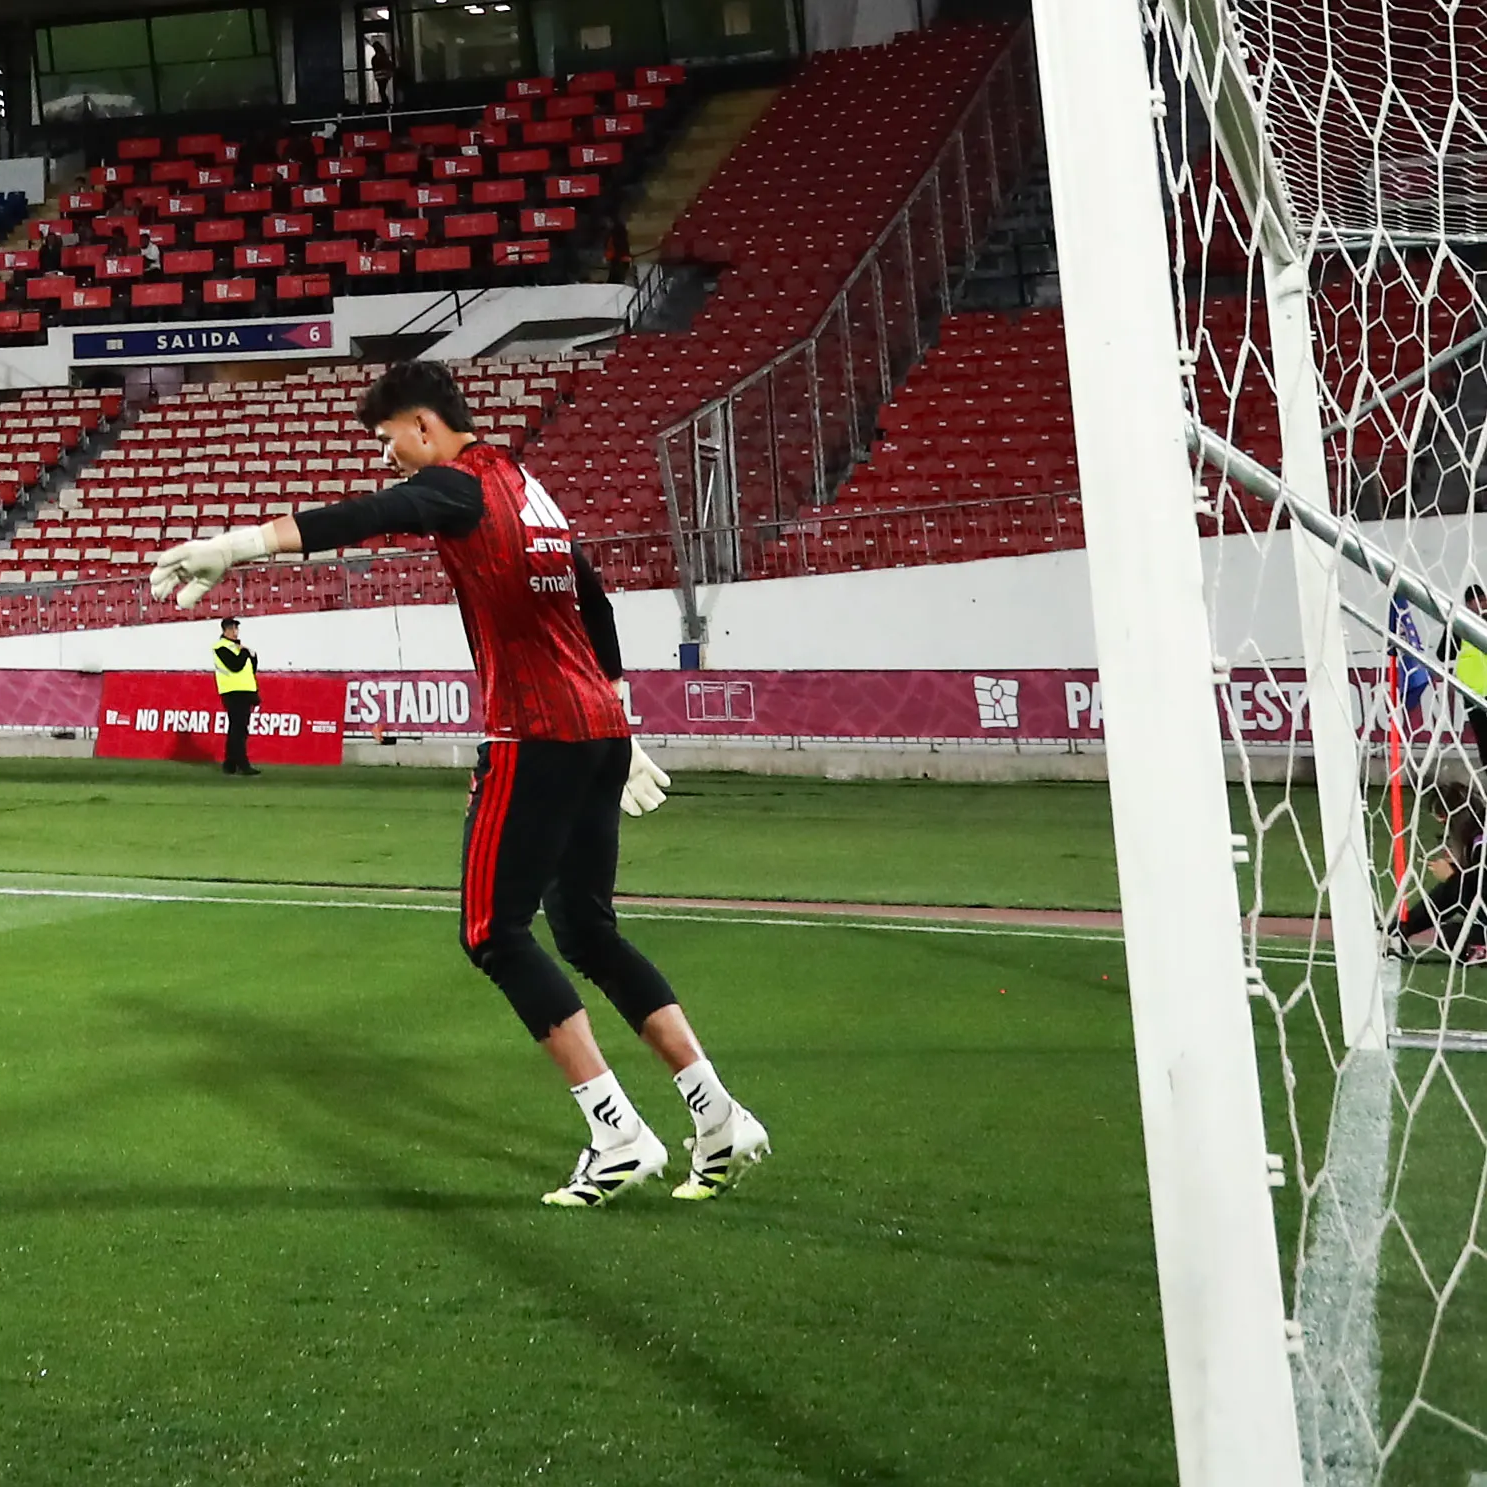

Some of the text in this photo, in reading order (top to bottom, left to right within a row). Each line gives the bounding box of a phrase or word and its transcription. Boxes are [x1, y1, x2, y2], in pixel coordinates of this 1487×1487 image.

[156, 326, 321, 350] SALIDA 6
[525, 537, 572, 554] JETOU
[343, 680, 471, 725] ESTADIO
[135, 709, 159, 732] NO
[163, 709, 210, 734] PISAR
[247, 706, 302, 737] ÉSPED
